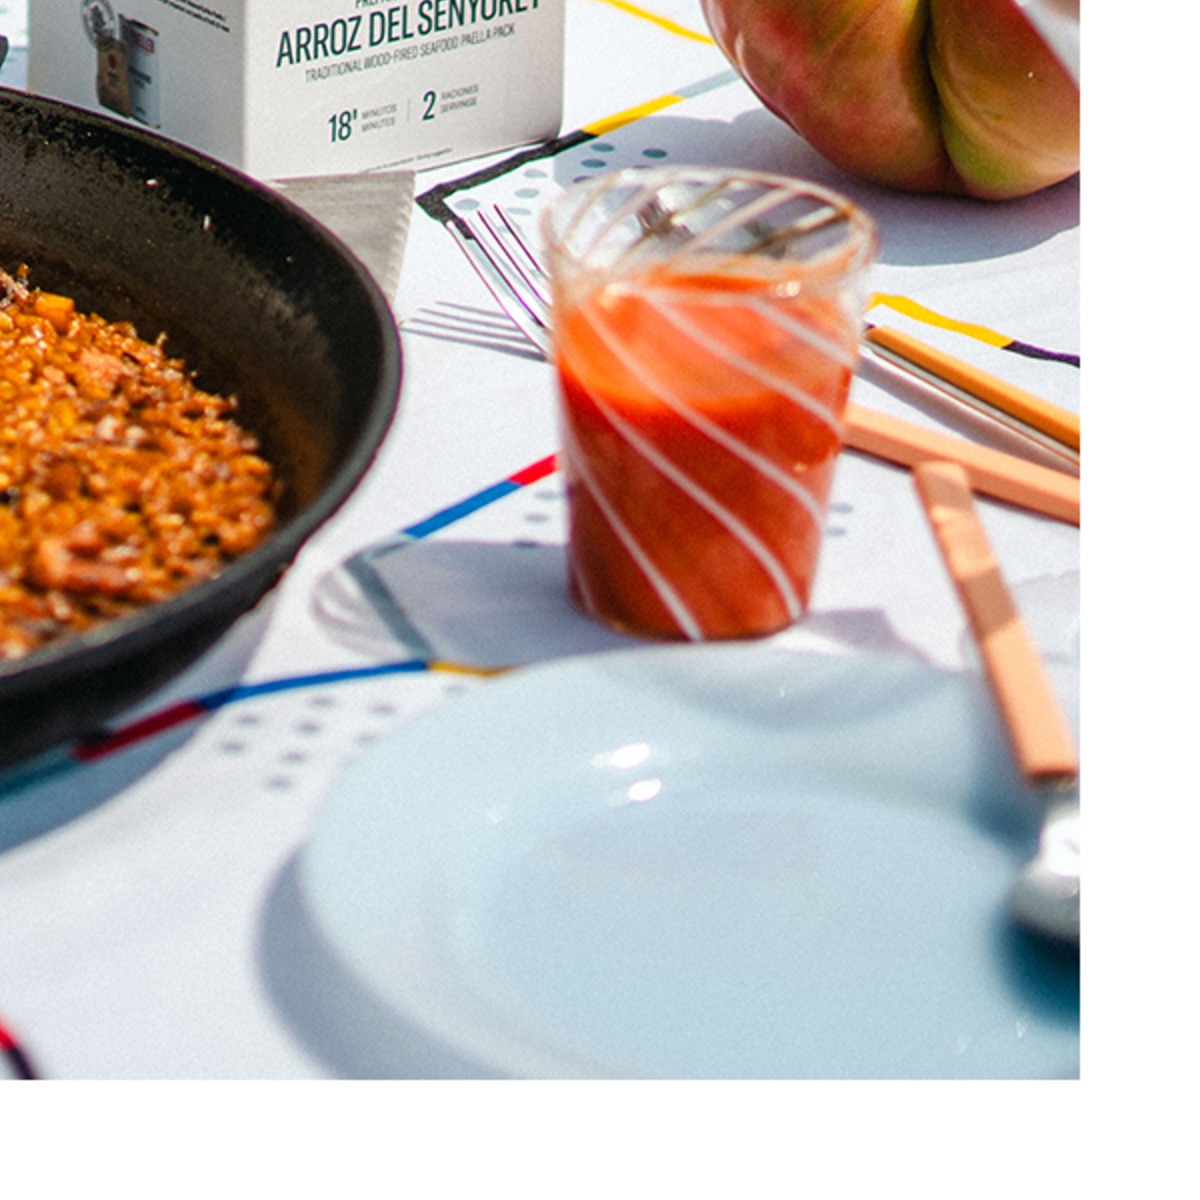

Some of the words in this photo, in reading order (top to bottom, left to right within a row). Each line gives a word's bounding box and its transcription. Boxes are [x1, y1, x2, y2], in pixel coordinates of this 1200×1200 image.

[275, 15, 362, 68] ARROZ
[369, 4, 414, 48] DEL
[305, 58, 363, 83] TRADITIONAL
[363, 43, 419, 70] WOOD-FIRED
[419, 36, 459, 58] SEAFOOD
[460, 29, 491, 48] PAELLA
[492, 21, 516, 41] PACK
[440, 84, 480, 101] RACIONES
[361, 103, 398, 120] MINUTOS
[421, 90, 437, 121] 2
[440, 97, 478, 115] SERVINGS
[361, 116, 396, 132] MINUTES
